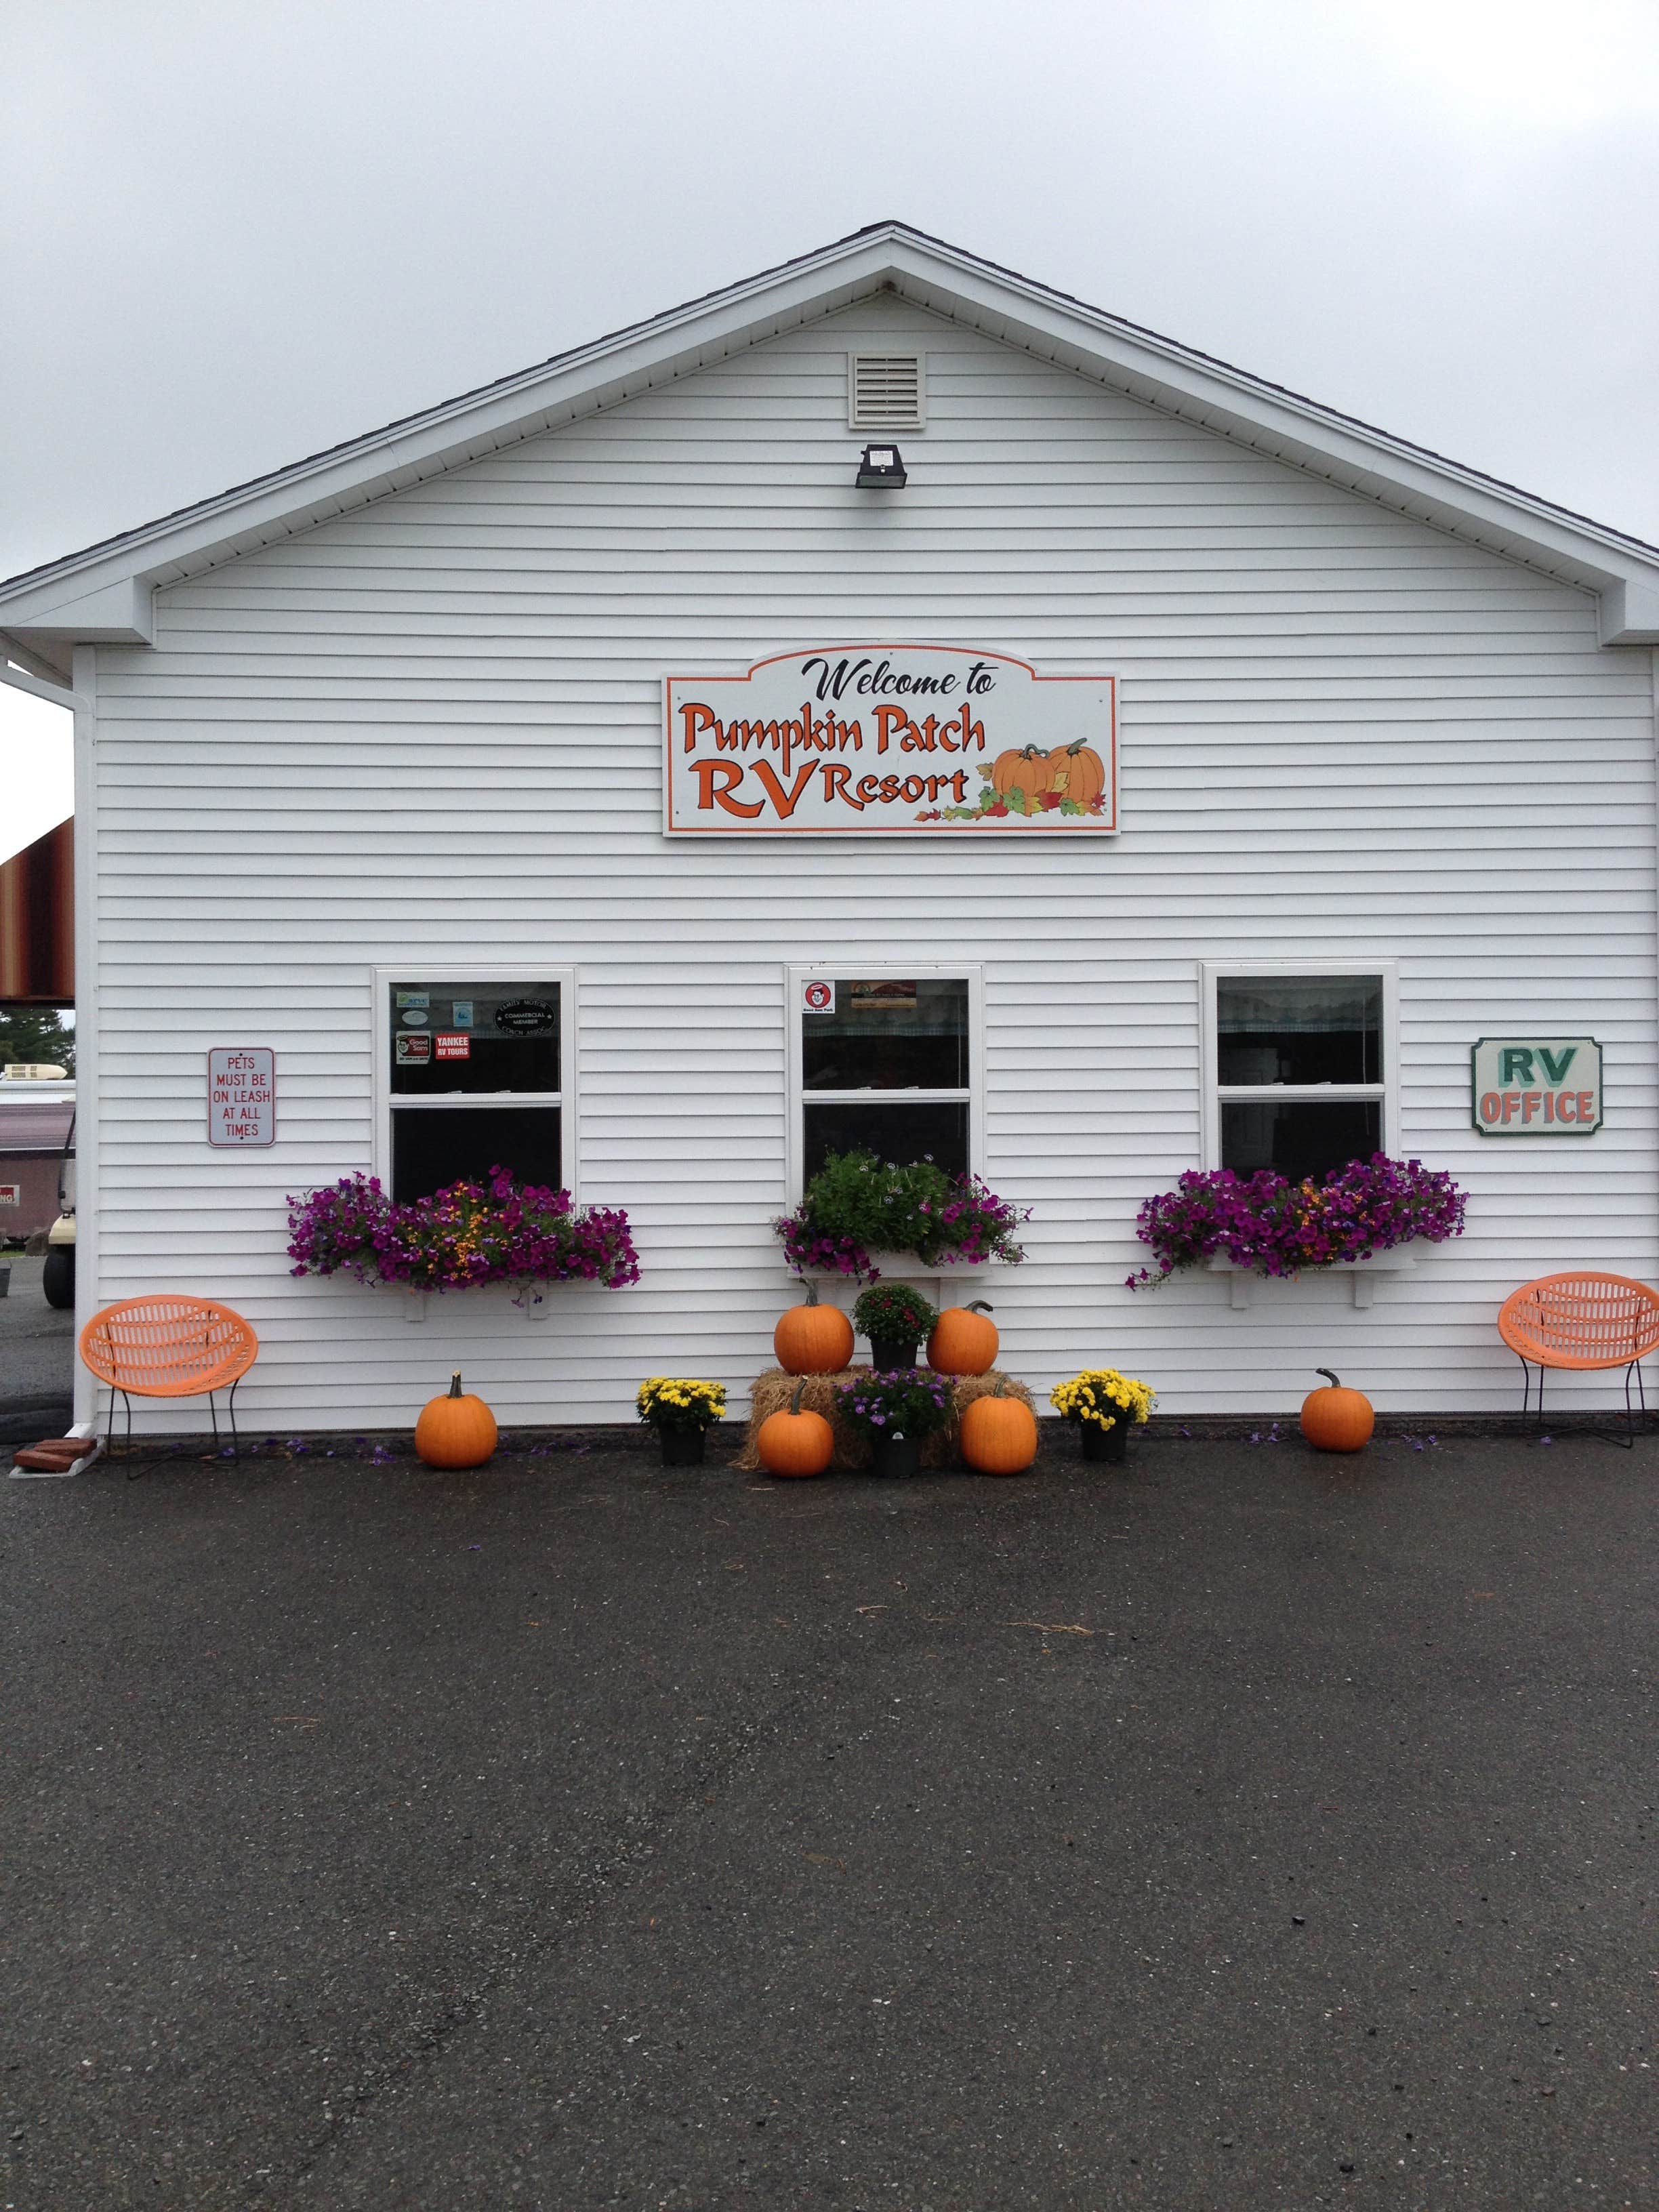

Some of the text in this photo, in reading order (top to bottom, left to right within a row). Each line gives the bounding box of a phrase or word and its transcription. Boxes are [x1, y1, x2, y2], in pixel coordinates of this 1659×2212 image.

[802, 657, 1000, 701] Welcome to
[678, 701, 986, 777] Pumpkin Patch
[689, 758, 970, 819] RV Resort
[437, 1037, 469, 1046] YANKEE
[228, 1057, 255, 1069] PETS
[1498, 1047, 1578, 1088] RV
[217, 1073, 266, 1086] MUST BE
[213, 1090, 270, 1103] ON LEASH
[222, 1107, 262, 1120] AT ALL
[1480, 1091, 1595, 1125] OFFICE
[226, 1124, 258, 1136] TIMES
